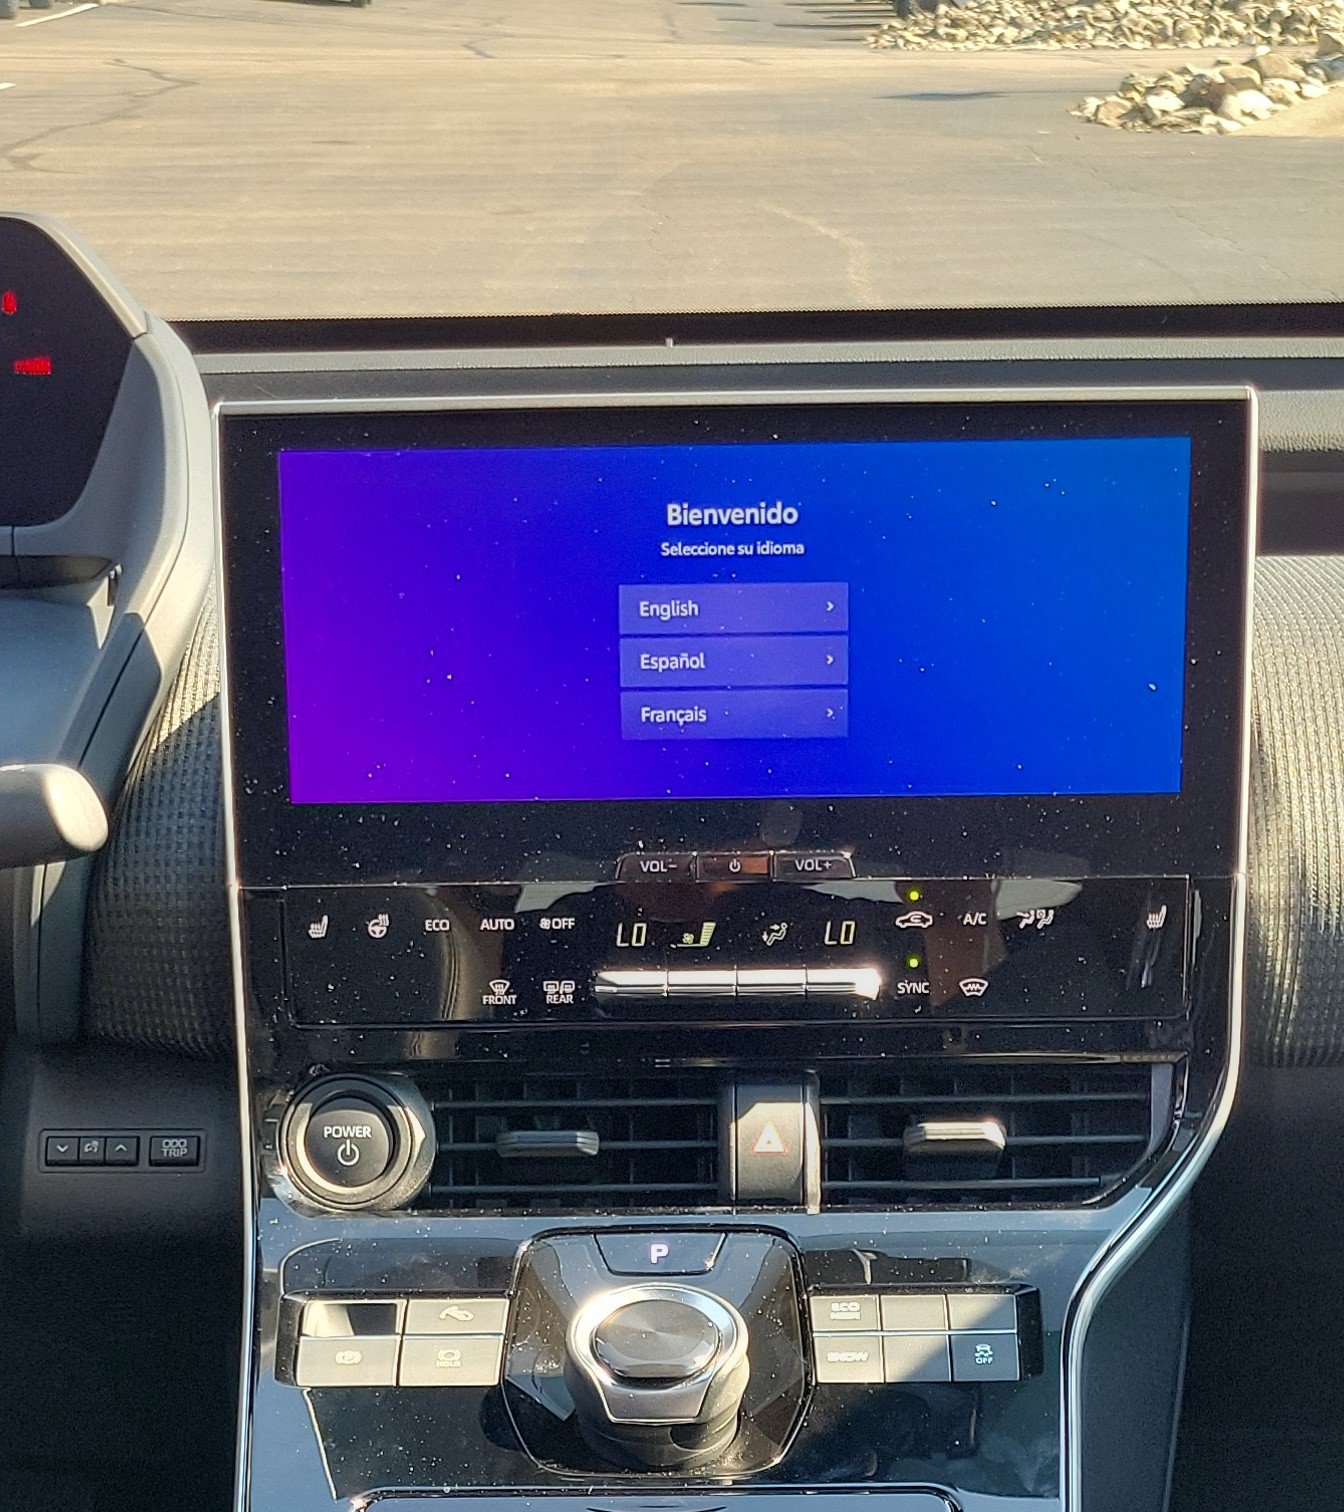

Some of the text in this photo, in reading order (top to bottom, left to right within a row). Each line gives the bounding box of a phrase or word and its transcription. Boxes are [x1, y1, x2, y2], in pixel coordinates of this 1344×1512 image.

[665, 501, 799, 526] Bienvenido
[660, 541, 805, 557] Seleccione su idioma
[639, 600, 699, 621] English
[640, 653, 706, 673] Español
[640, 706, 707, 727] Français
[424, 919, 451, 932] ECO
[480, 918, 515, 932] AUTO
[552, 917, 576, 931] OFF
[962, 911, 987, 927] A/C
[616, 922, 648, 947] LO
[824, 920, 856, 946] LO
[897, 980, 931, 995] SYNC
[482, 994, 517, 1006] FRONT
[545, 992, 574, 1005] REAR
[323, 1125, 372, 1139] POWER
[162, 1139, 188, 1149] ODO
[162, 1148, 188, 1158] TRIP
[650, 1243, 669, 1264] P
[975, 1356, 994, 1365] OFF
